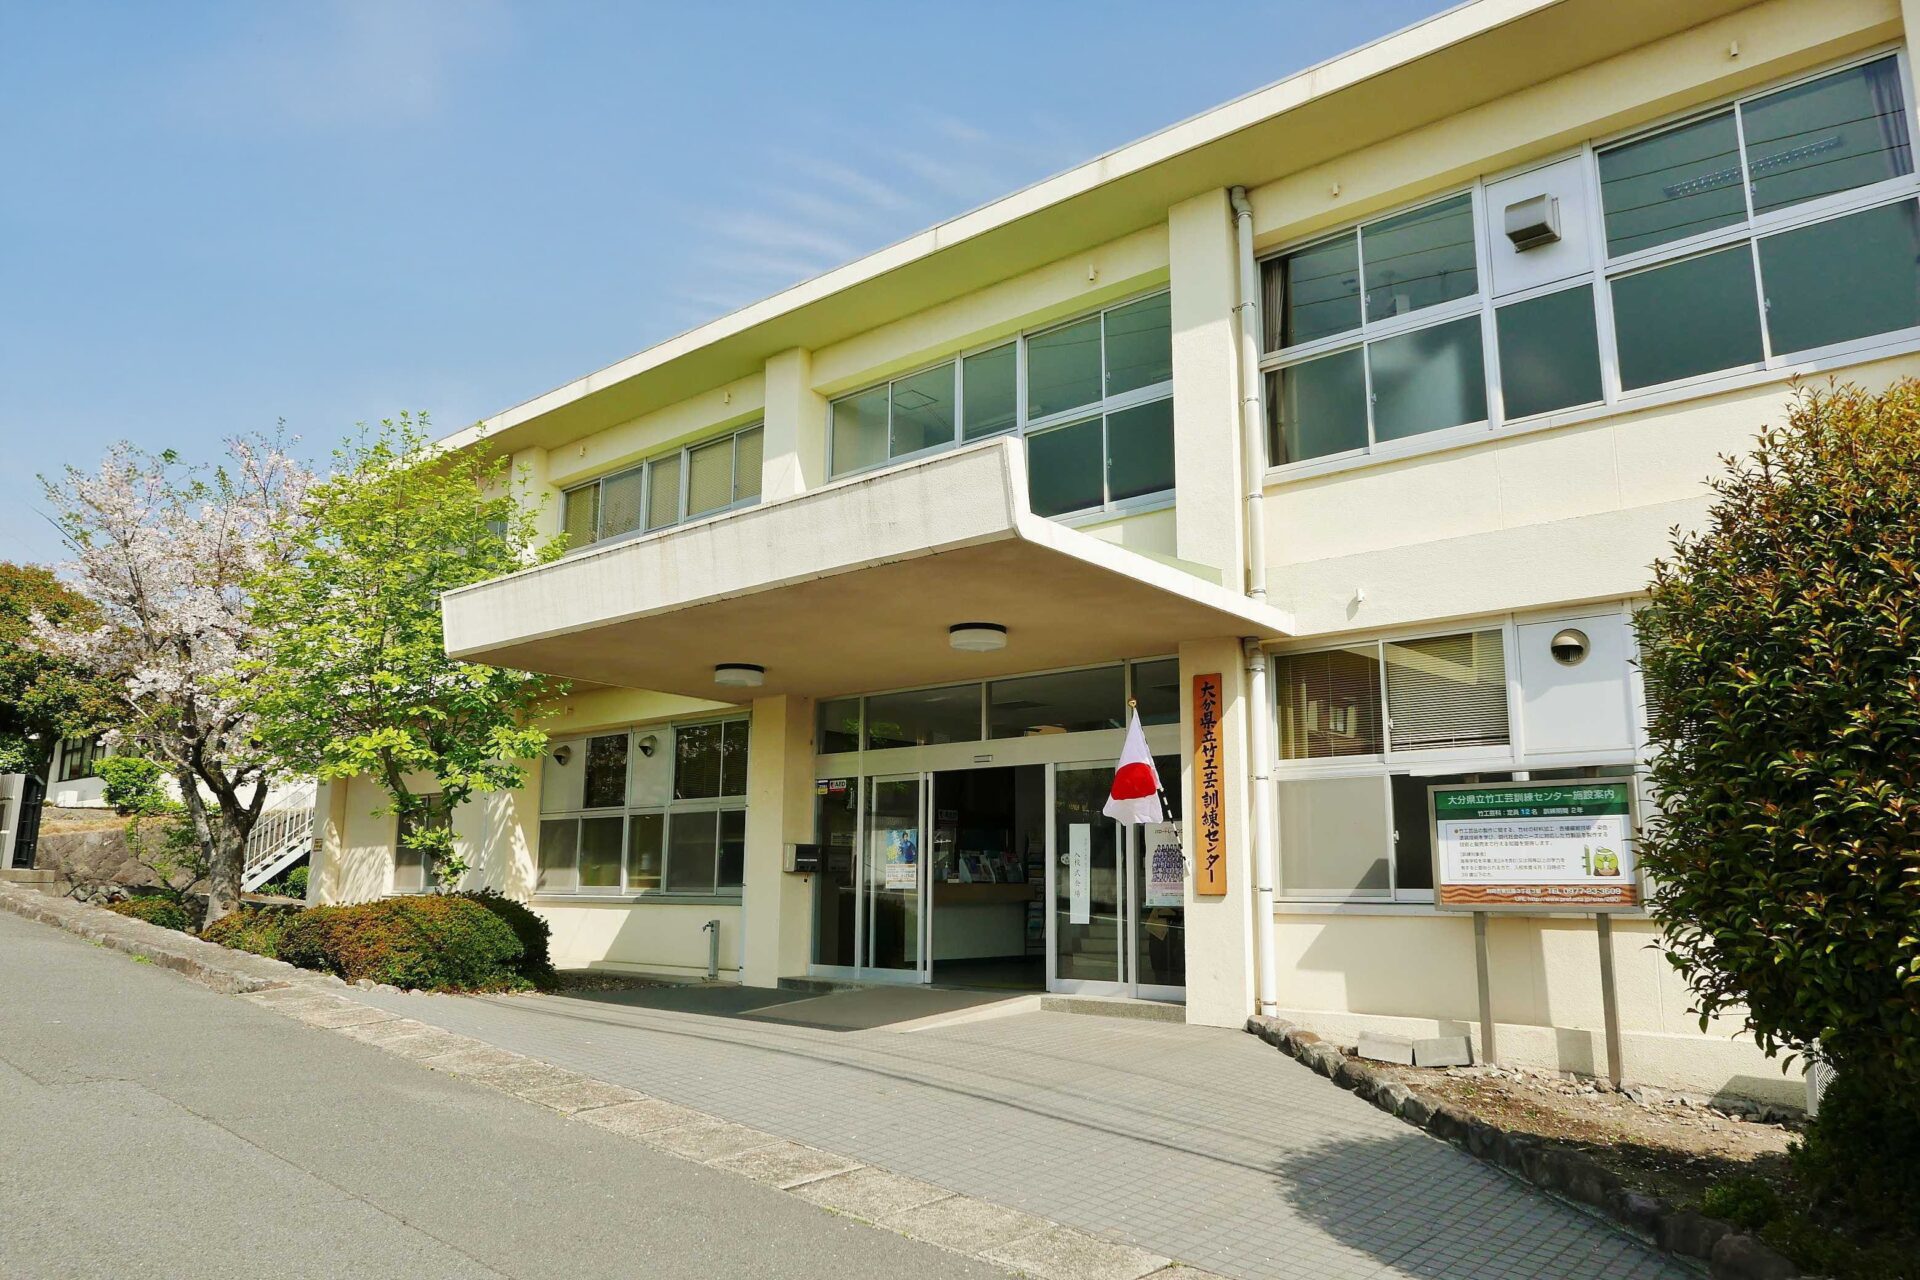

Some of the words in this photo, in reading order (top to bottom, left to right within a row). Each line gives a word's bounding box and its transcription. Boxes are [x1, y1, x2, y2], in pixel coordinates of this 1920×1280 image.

[1200, 681, 1220, 883] 大分県立竹工芸訓練センター
[1448, 789, 1615, 805] 大分県立竹工芸訓練センター施設案内
